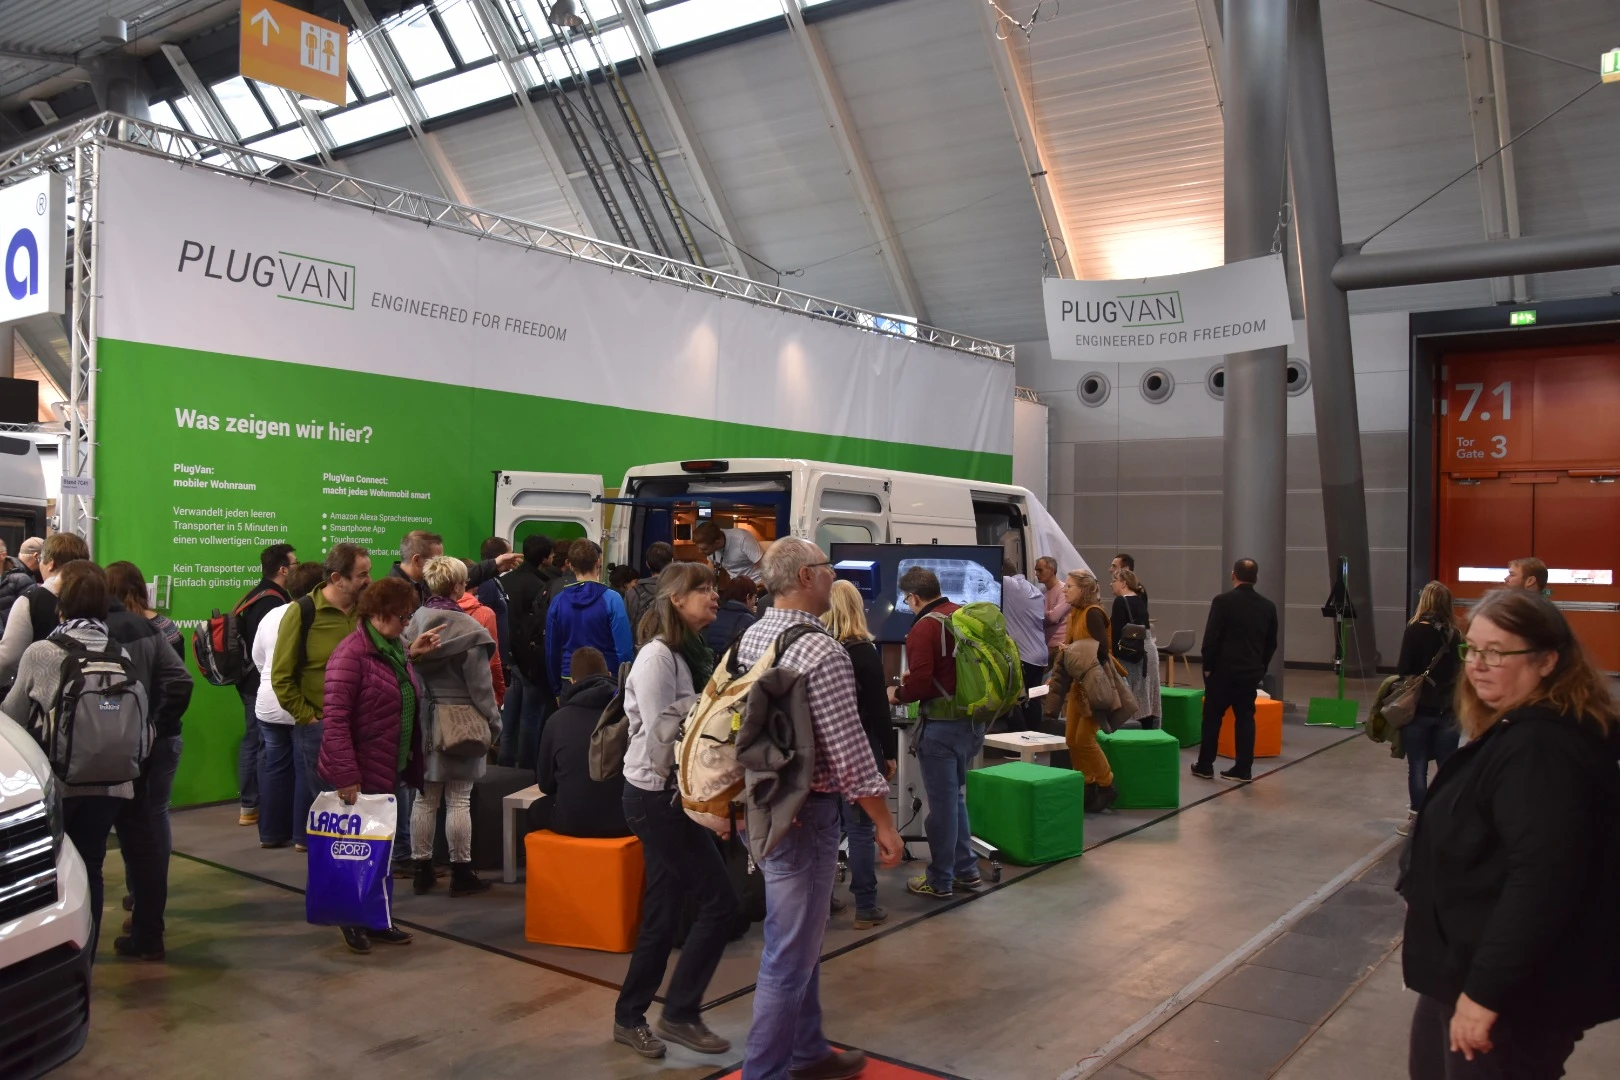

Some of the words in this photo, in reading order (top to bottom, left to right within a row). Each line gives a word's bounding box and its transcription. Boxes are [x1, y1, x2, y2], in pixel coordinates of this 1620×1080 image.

[177, 239, 349, 302] PLUGVAN
[1061, 296, 1177, 323] PLUGVAN
[371, 291, 468, 324] ENGINEERED
[472, 311, 501, 330] FOR
[504, 317, 568, 342] FREEDOM
[1075, 334, 1155, 347] ENGINEERED
[1159, 331, 1188, 345] FOR
[1193, 318, 1267, 342] FREEDOM
[1455, 381, 1512, 422] 7.1
[175, 407, 220, 431] Was
[225, 413, 290, 440] zeigen
[296, 419, 324, 440] wir
[328, 421, 374, 444] hier?
[1456, 436, 1476, 447] Tor
[1456, 448, 1485, 459] Gate
[1490, 435, 1508, 459] 3
[173, 463, 215, 475] PlugVan:
[173, 478, 208, 488] mobiler
[210, 479, 257, 491] Wohnraum
[323, 472, 355, 484] PlugVan
[355, 475, 389, 485] Connect:
[322, 486, 347, 495] macht
[347, 487, 368, 497] jedes
[369, 488, 410, 499] Wohnmobil
[410, 492, 431, 500] smart
[173, 506, 223, 517] Verwandelt
[225, 507, 249, 519] jeden
[250, 508, 276, 519] leeren
[330, 512, 358, 521] Amazon
[359, 513, 378, 522] Alexa
[379, 513, 433, 525] Sprachsteuerung
[173, 520, 225, 532] Transporter
[226, 522, 235, 531] in
[237, 522, 243, 531] 5
[244, 522, 279, 532] Minuten
[280, 523, 288, 532] in
[330, 523, 372, 533] Smartphone
[372, 524, 386, 534] App
[173, 535, 198, 544] einen
[200, 535, 252, 547] vollwertigen
[330, 535, 374, 544] Touchscreen
[173, 563, 193, 573] Kein
[194, 563, 246, 575] Transporter
[173, 577, 207, 587] Einfach
[208, 577, 241, 589] günstig
[309, 810, 362, 835] LARCA
[333, 843, 366, 856] SPORT
